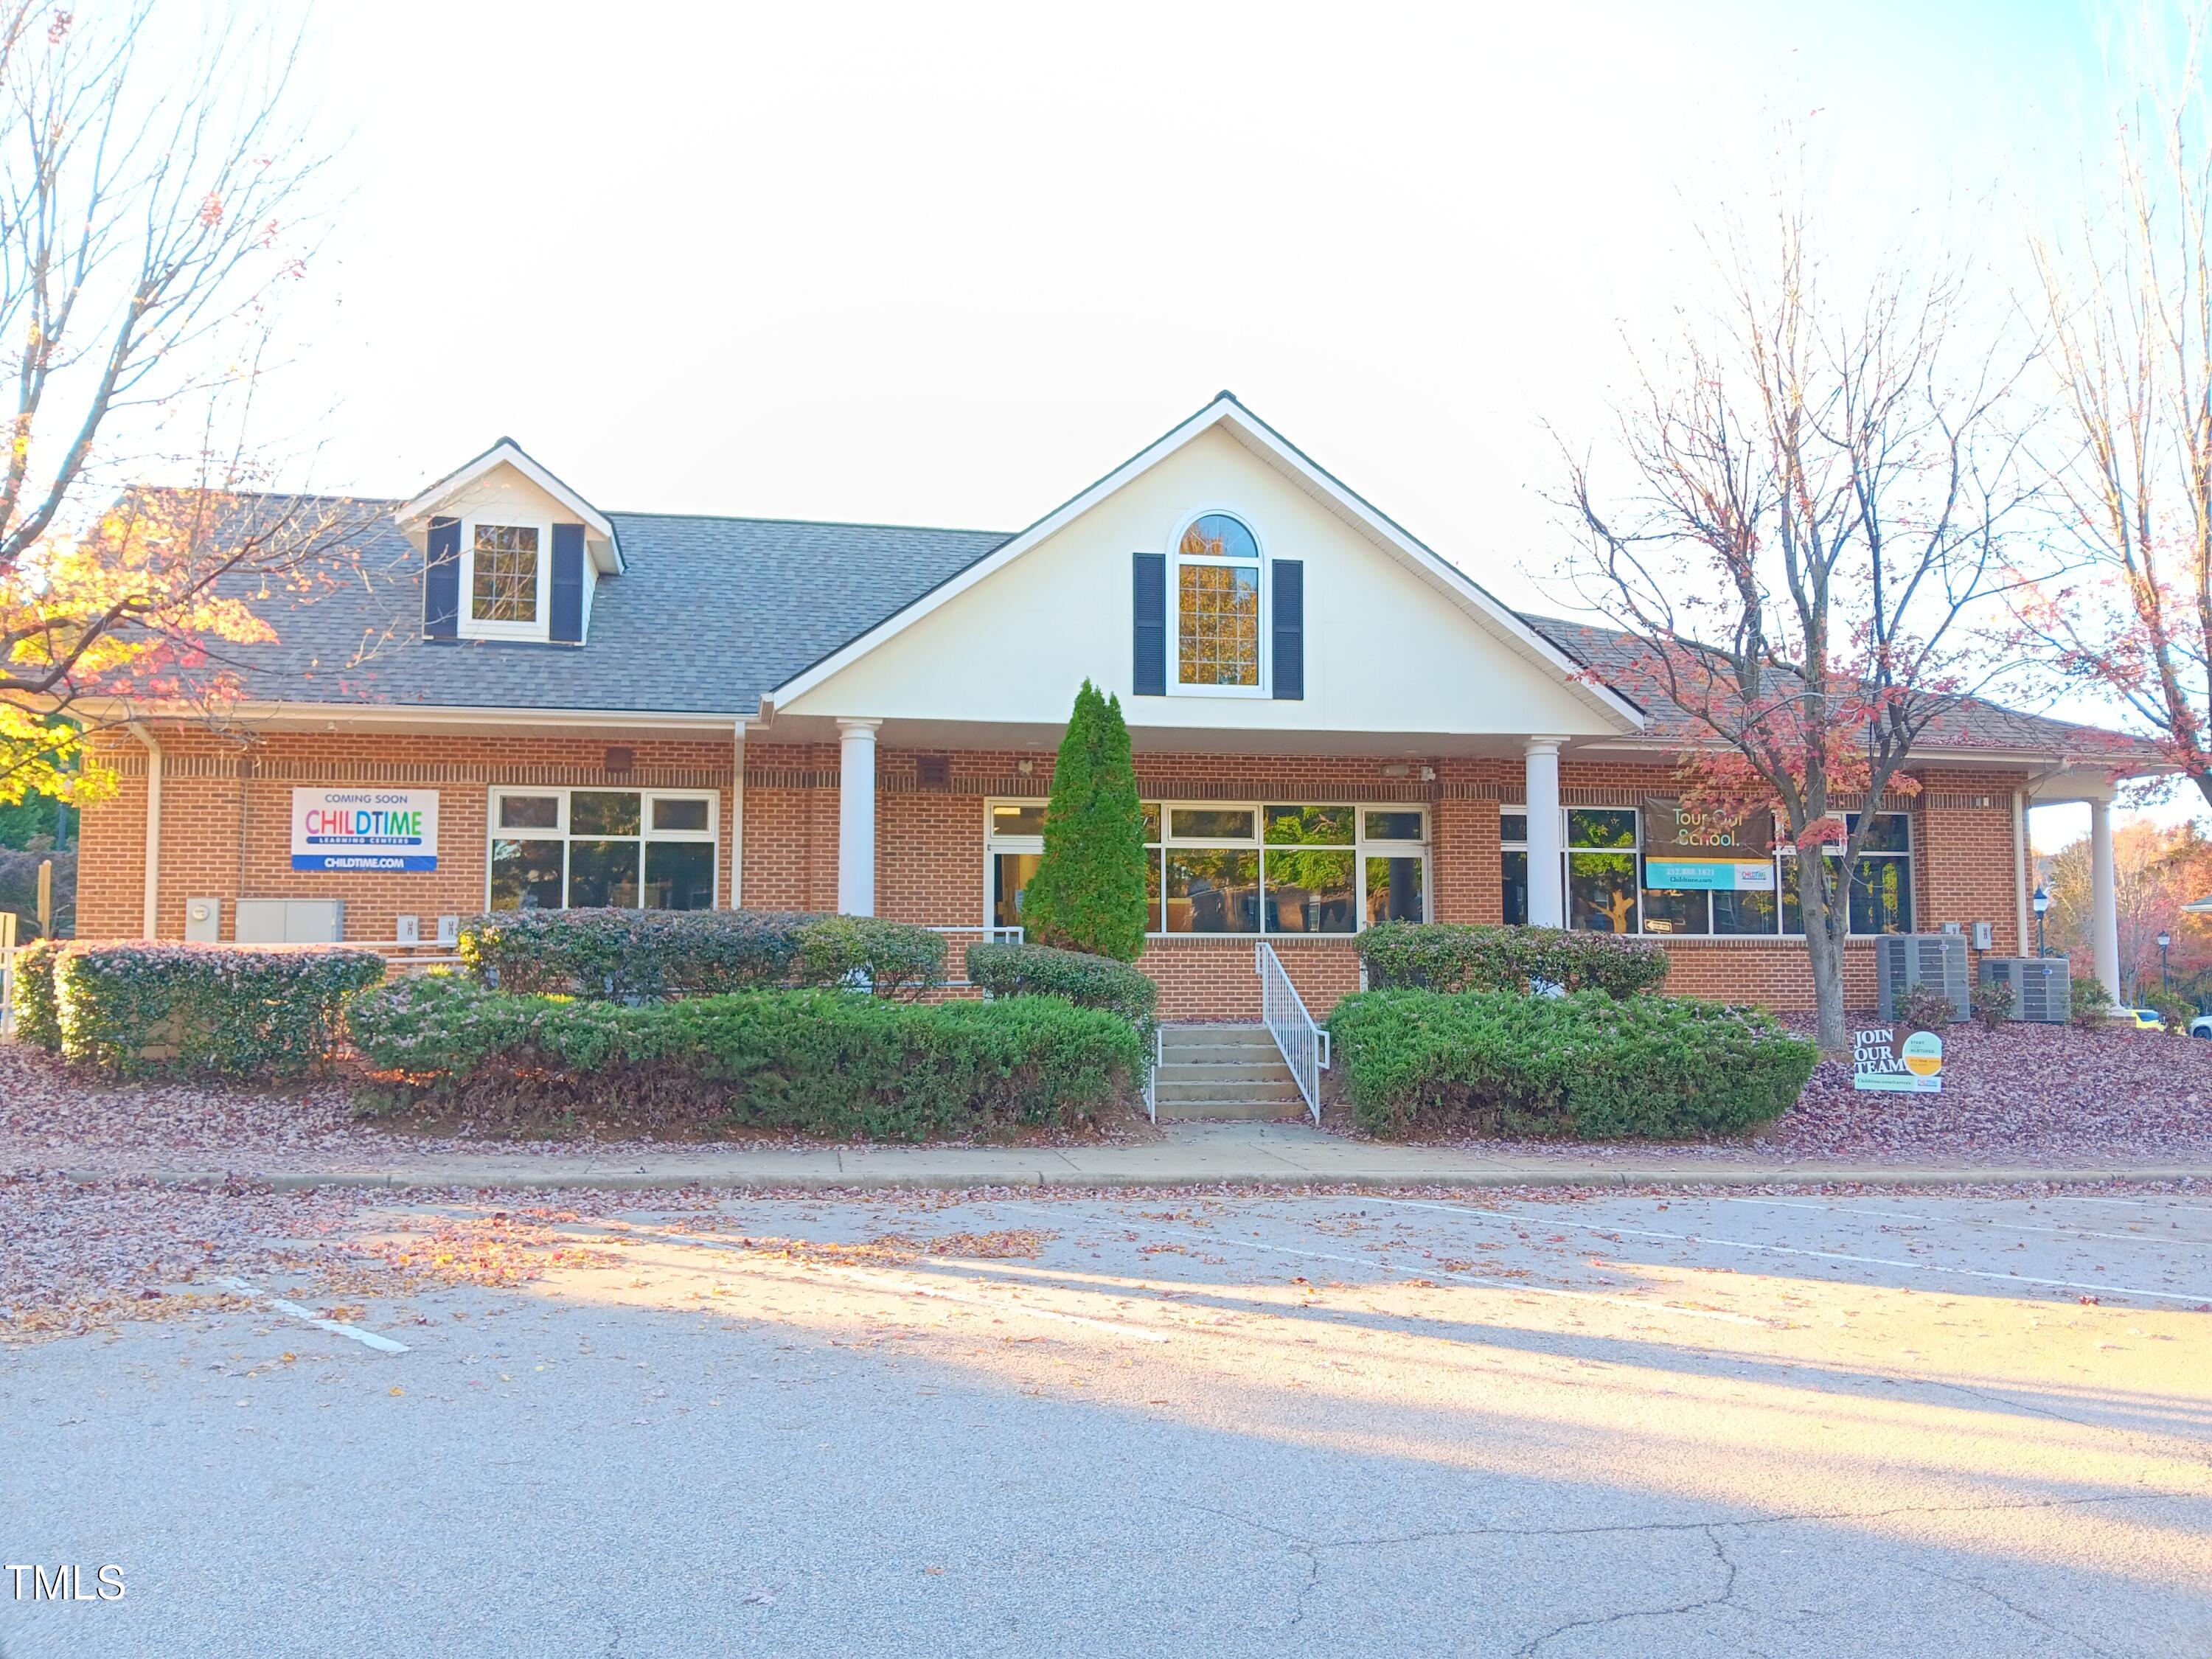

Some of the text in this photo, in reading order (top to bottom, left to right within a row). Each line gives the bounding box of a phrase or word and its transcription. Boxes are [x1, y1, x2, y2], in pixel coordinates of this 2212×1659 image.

[325, 794, 408, 804] COMING SOON
[305, 810, 422, 835] CHILDTIME
[1672, 808, 1708, 825] Tour
[324, 858, 404, 869] CHILDTIME.COM
[1854, 1029, 1893, 1048] JOIN
[1854, 1046, 1893, 1062] OUR
